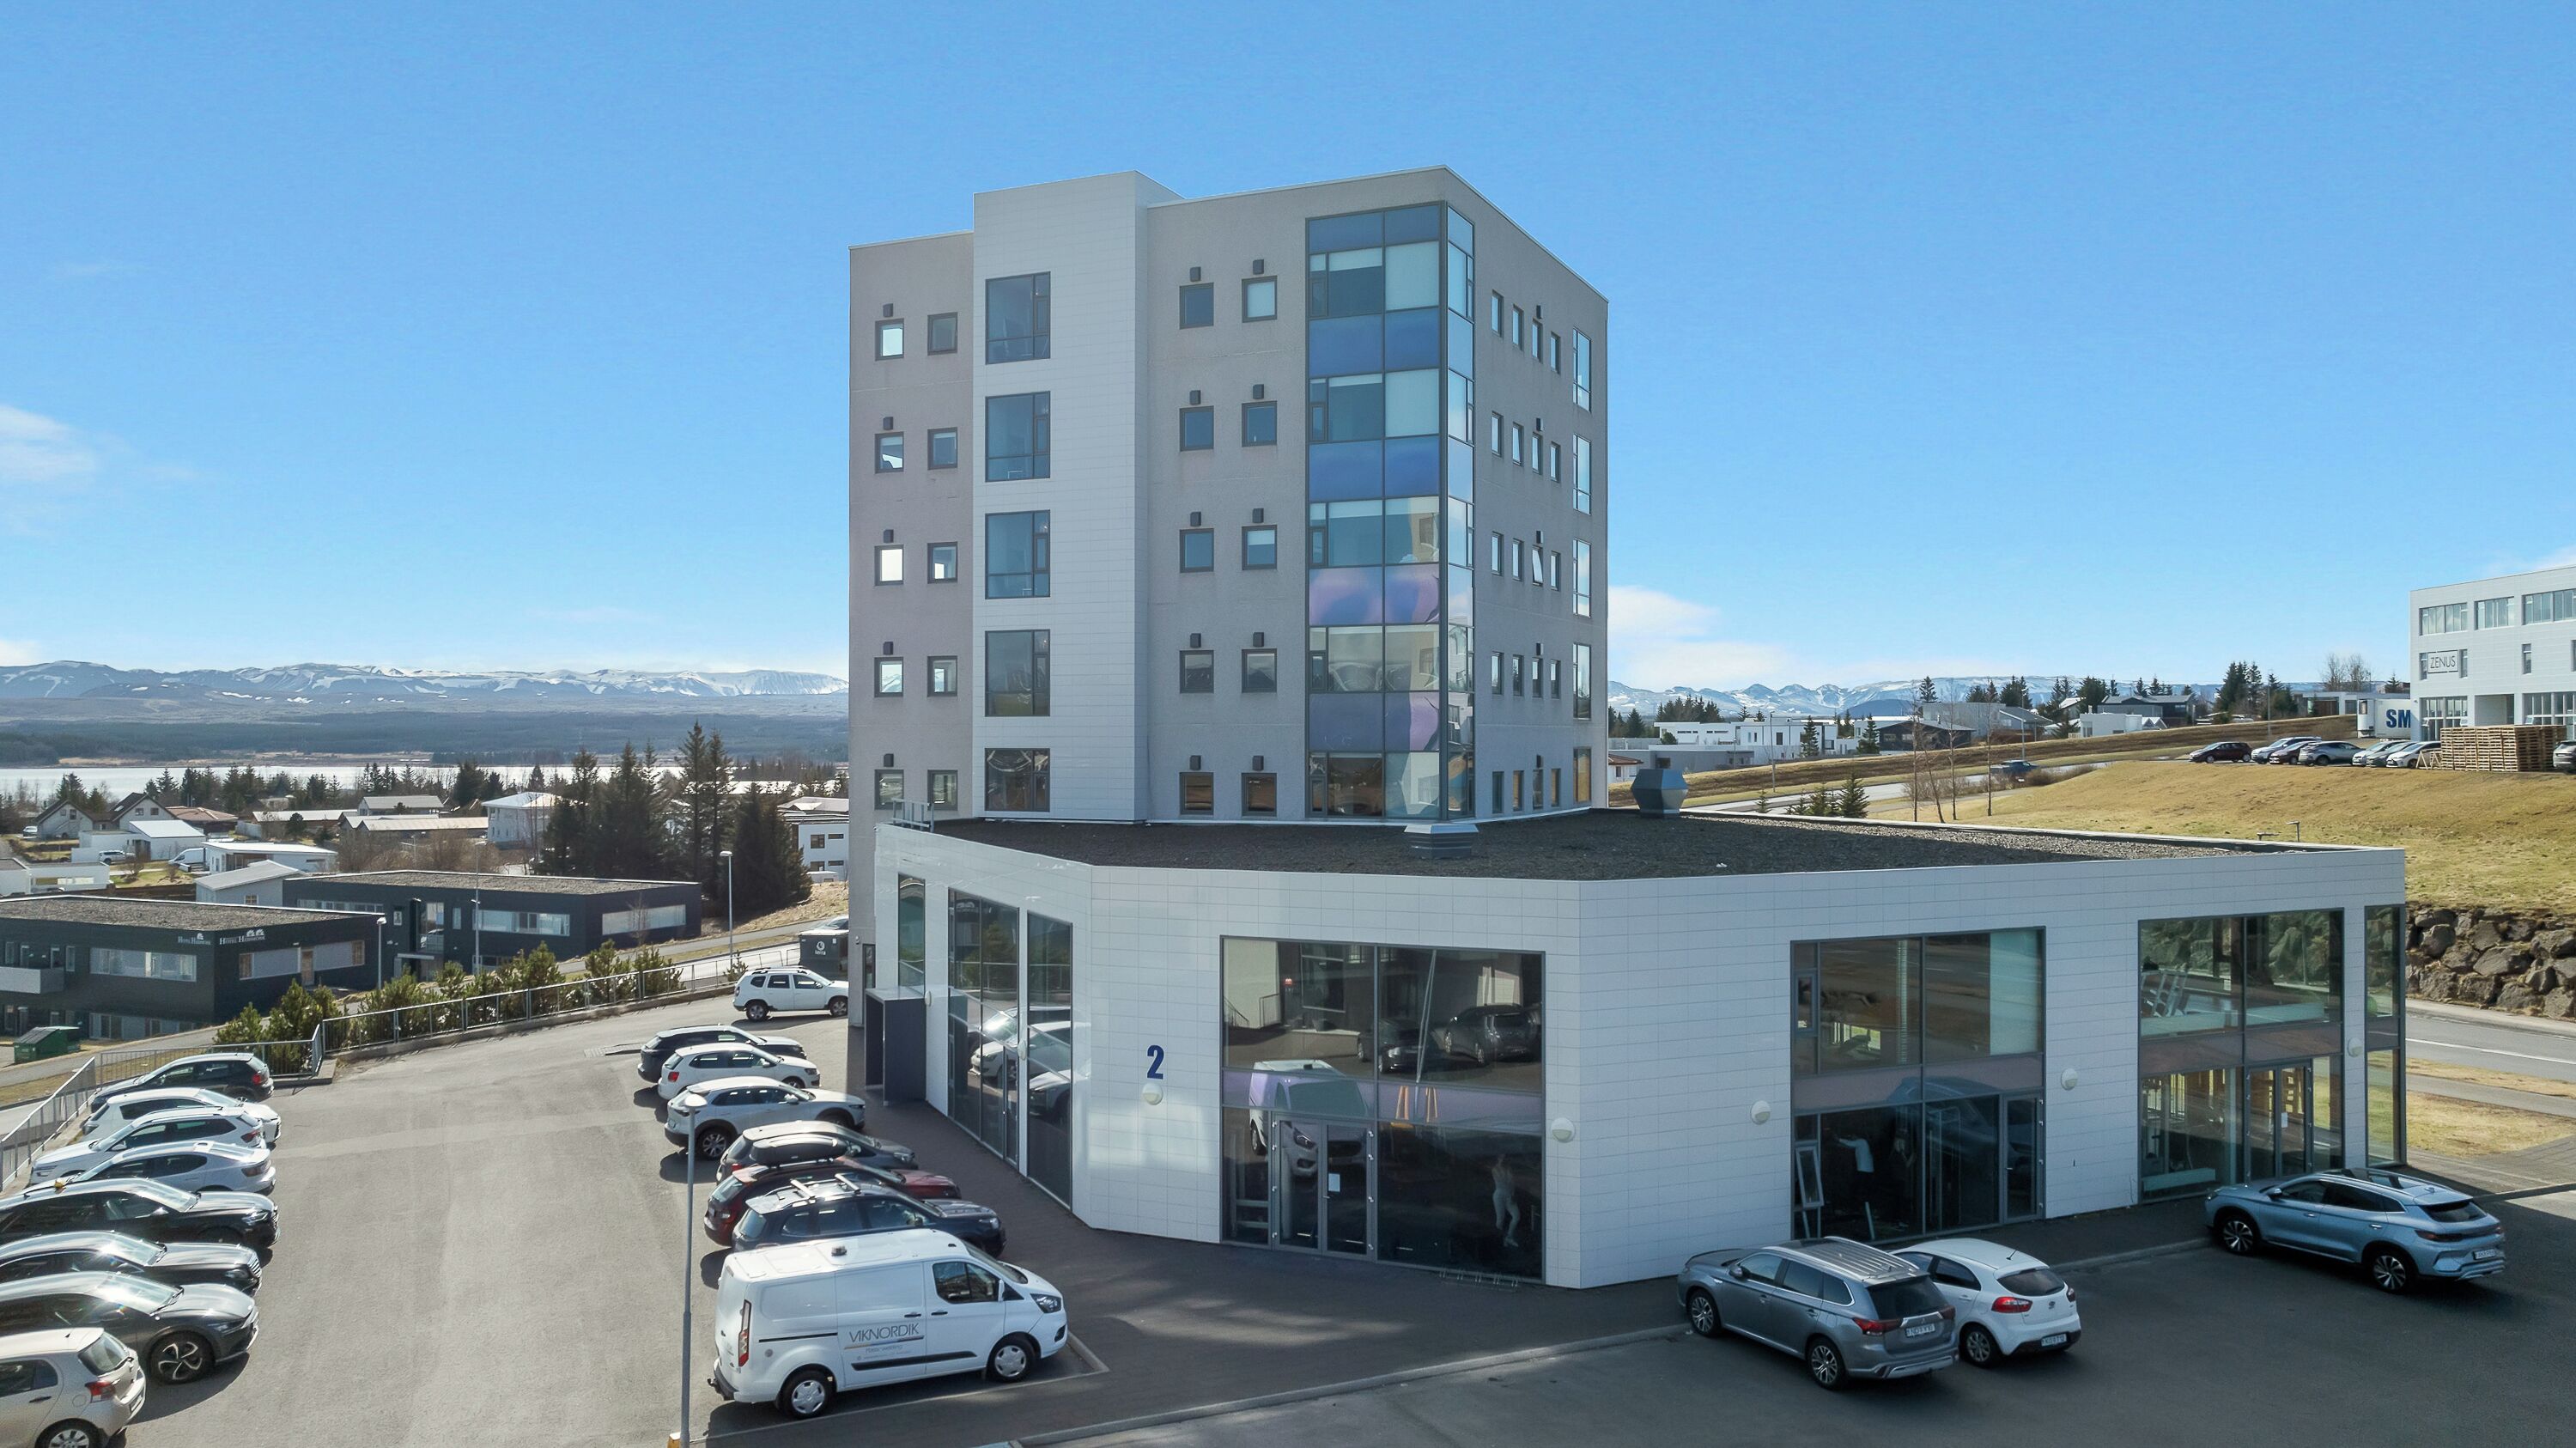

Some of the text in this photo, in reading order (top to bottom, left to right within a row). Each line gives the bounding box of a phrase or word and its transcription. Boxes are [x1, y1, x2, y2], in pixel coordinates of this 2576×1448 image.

[2430, 656, 2456, 669] ZENUS
[2386, 709, 2410, 728] SM
[1147, 1044, 1164, 1080] 2
[849, 1323, 920, 1342] VIKNORDIK
